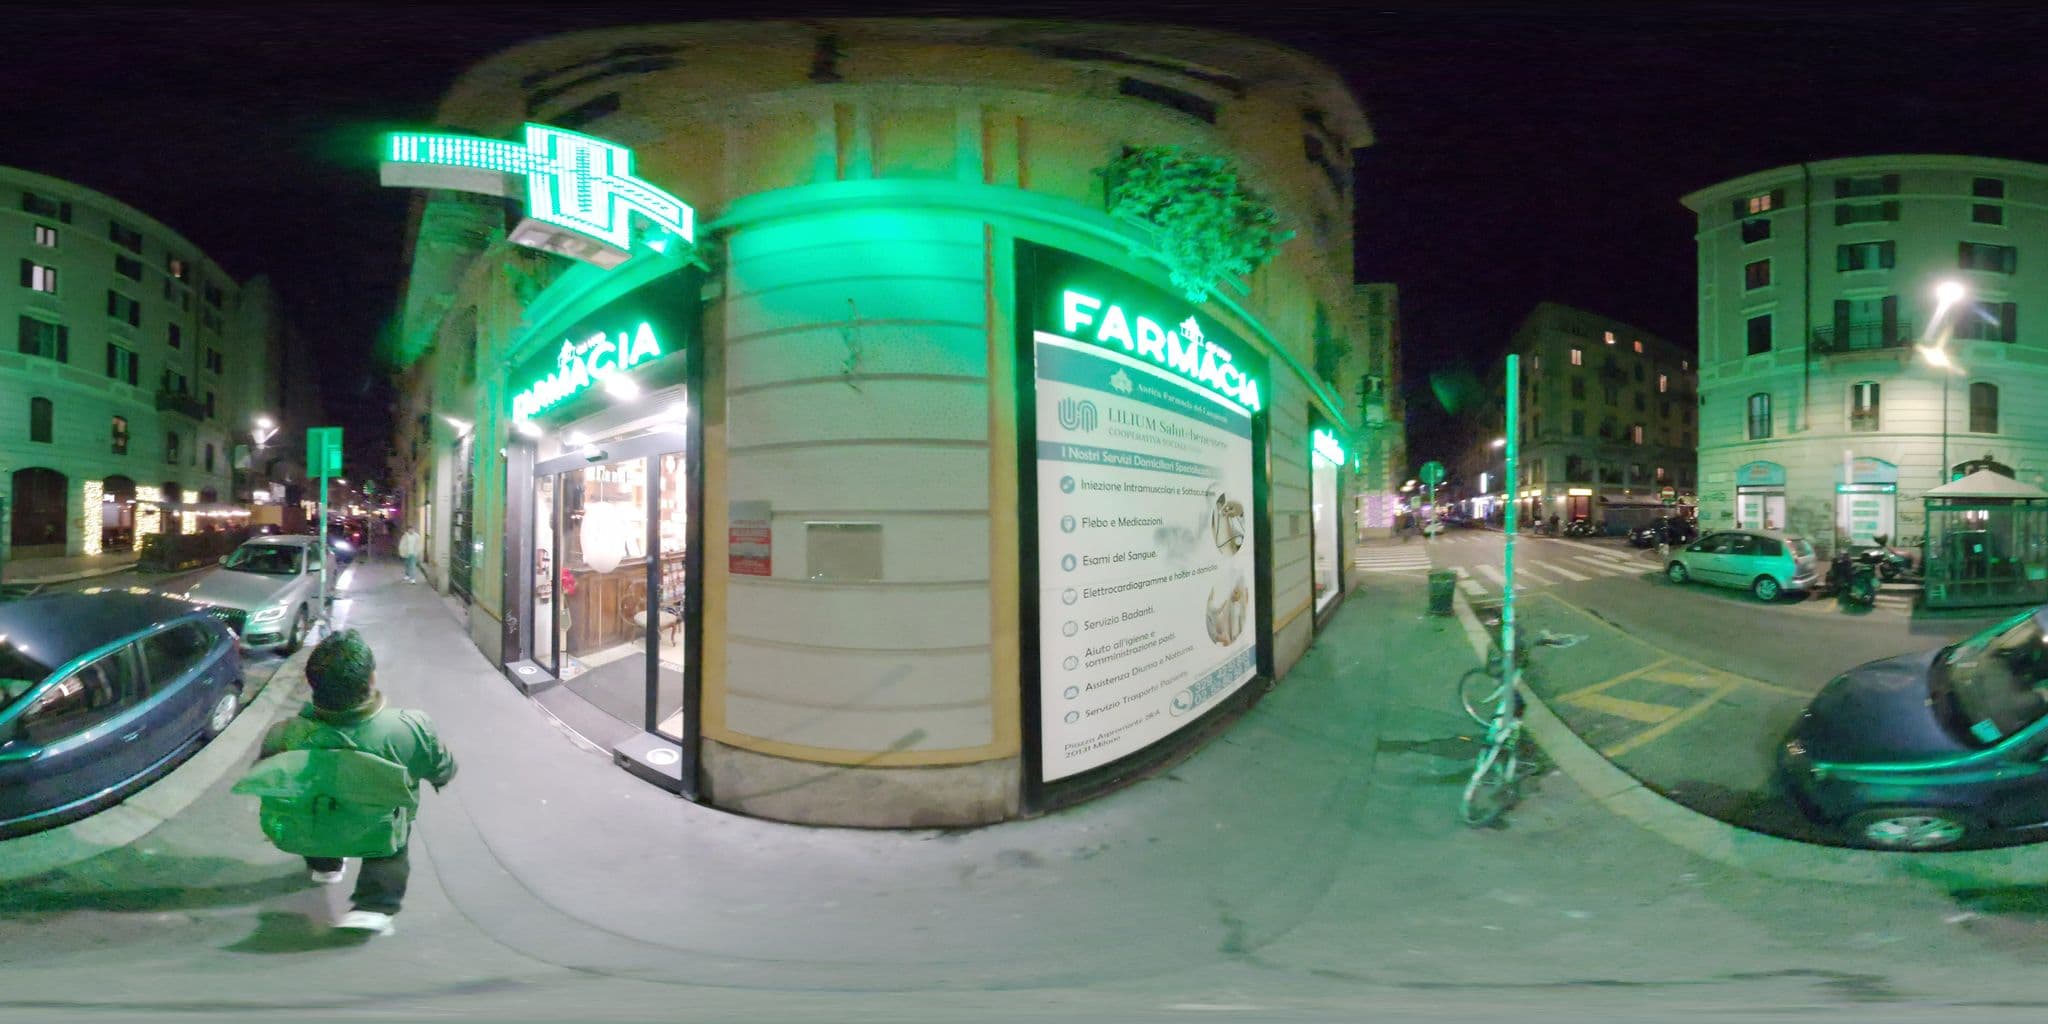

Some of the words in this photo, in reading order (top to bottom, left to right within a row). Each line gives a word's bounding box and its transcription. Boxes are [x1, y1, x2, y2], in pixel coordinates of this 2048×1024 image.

[1062, 289, 1262, 412] FARMACIA
[512, 321, 661, 424] FARMACIA
[1107, 406, 1157, 431] LILIUM
[1068, 446, 1100, 460] Nostri
[1102, 451, 1133, 463] Servizi
[1080, 478, 1121, 492] Iniezione
[1123, 482, 1176, 496] Intramuscolari
[1081, 517, 1109, 529] Flebo
[1110, 519, 1117, 527] e
[1082, 553, 1111, 567] Esami
[1112, 551, 1127, 563] del
[1168, 574, 1174, 582] e
[1083, 615, 1120, 631] Servizio
[1085, 643, 1113, 658] Aiuto
[1113, 631, 1150, 649] all'igiene
[1150, 630, 1156, 639] e
[1084, 641, 1158, 669] somministrazione
[1085, 670, 1131, 692] Assistenza
[1159, 658, 1165, 666] e
[1085, 700, 1121, 718] Servizio
[1121, 685, 1160, 707] Trasporto
[1064, 737, 1096, 752] Piazza
